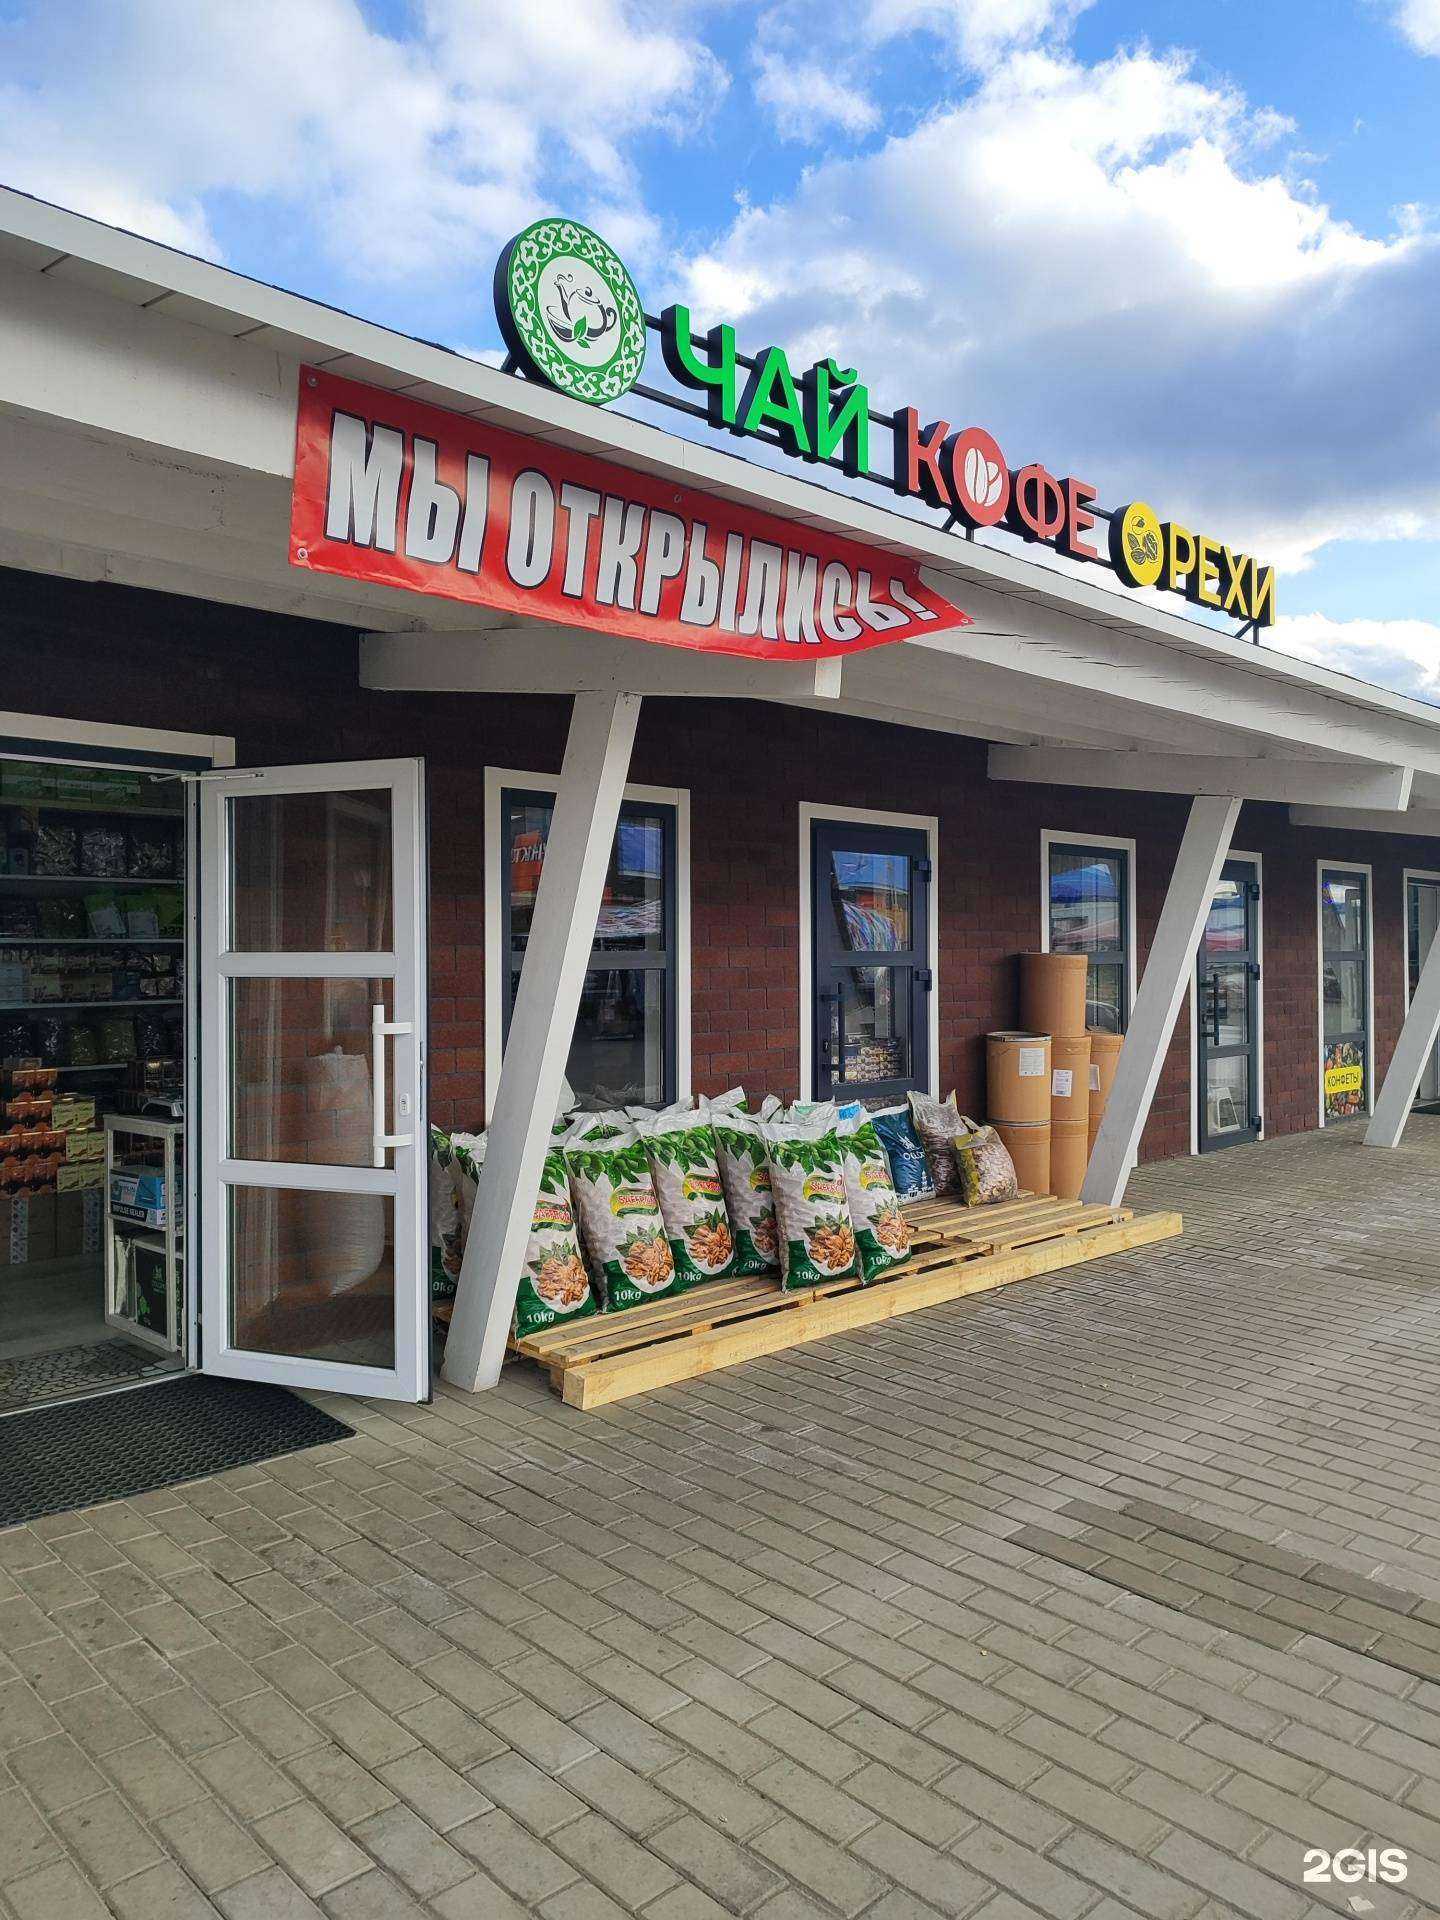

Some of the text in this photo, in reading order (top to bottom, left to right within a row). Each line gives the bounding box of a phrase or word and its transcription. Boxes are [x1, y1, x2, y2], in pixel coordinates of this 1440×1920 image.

[661, 303, 1275, 627] ЧАЙ КОФЕ ОРЕХИ
[323, 409, 938, 644] МЫ ОТКРЫЛИСЬ!
[1327, 1072, 1360, 1088] КОНФЕТЫ
[870, 1254, 892, 1266] 10kg
[677, 1271, 702, 1282] 10kg
[797, 1267, 820, 1281] 10kg
[431, 1280, 455, 1294] 0kg
[614, 1289, 642, 1302] 10kg
[526, 1310, 555, 1324] 10kg
